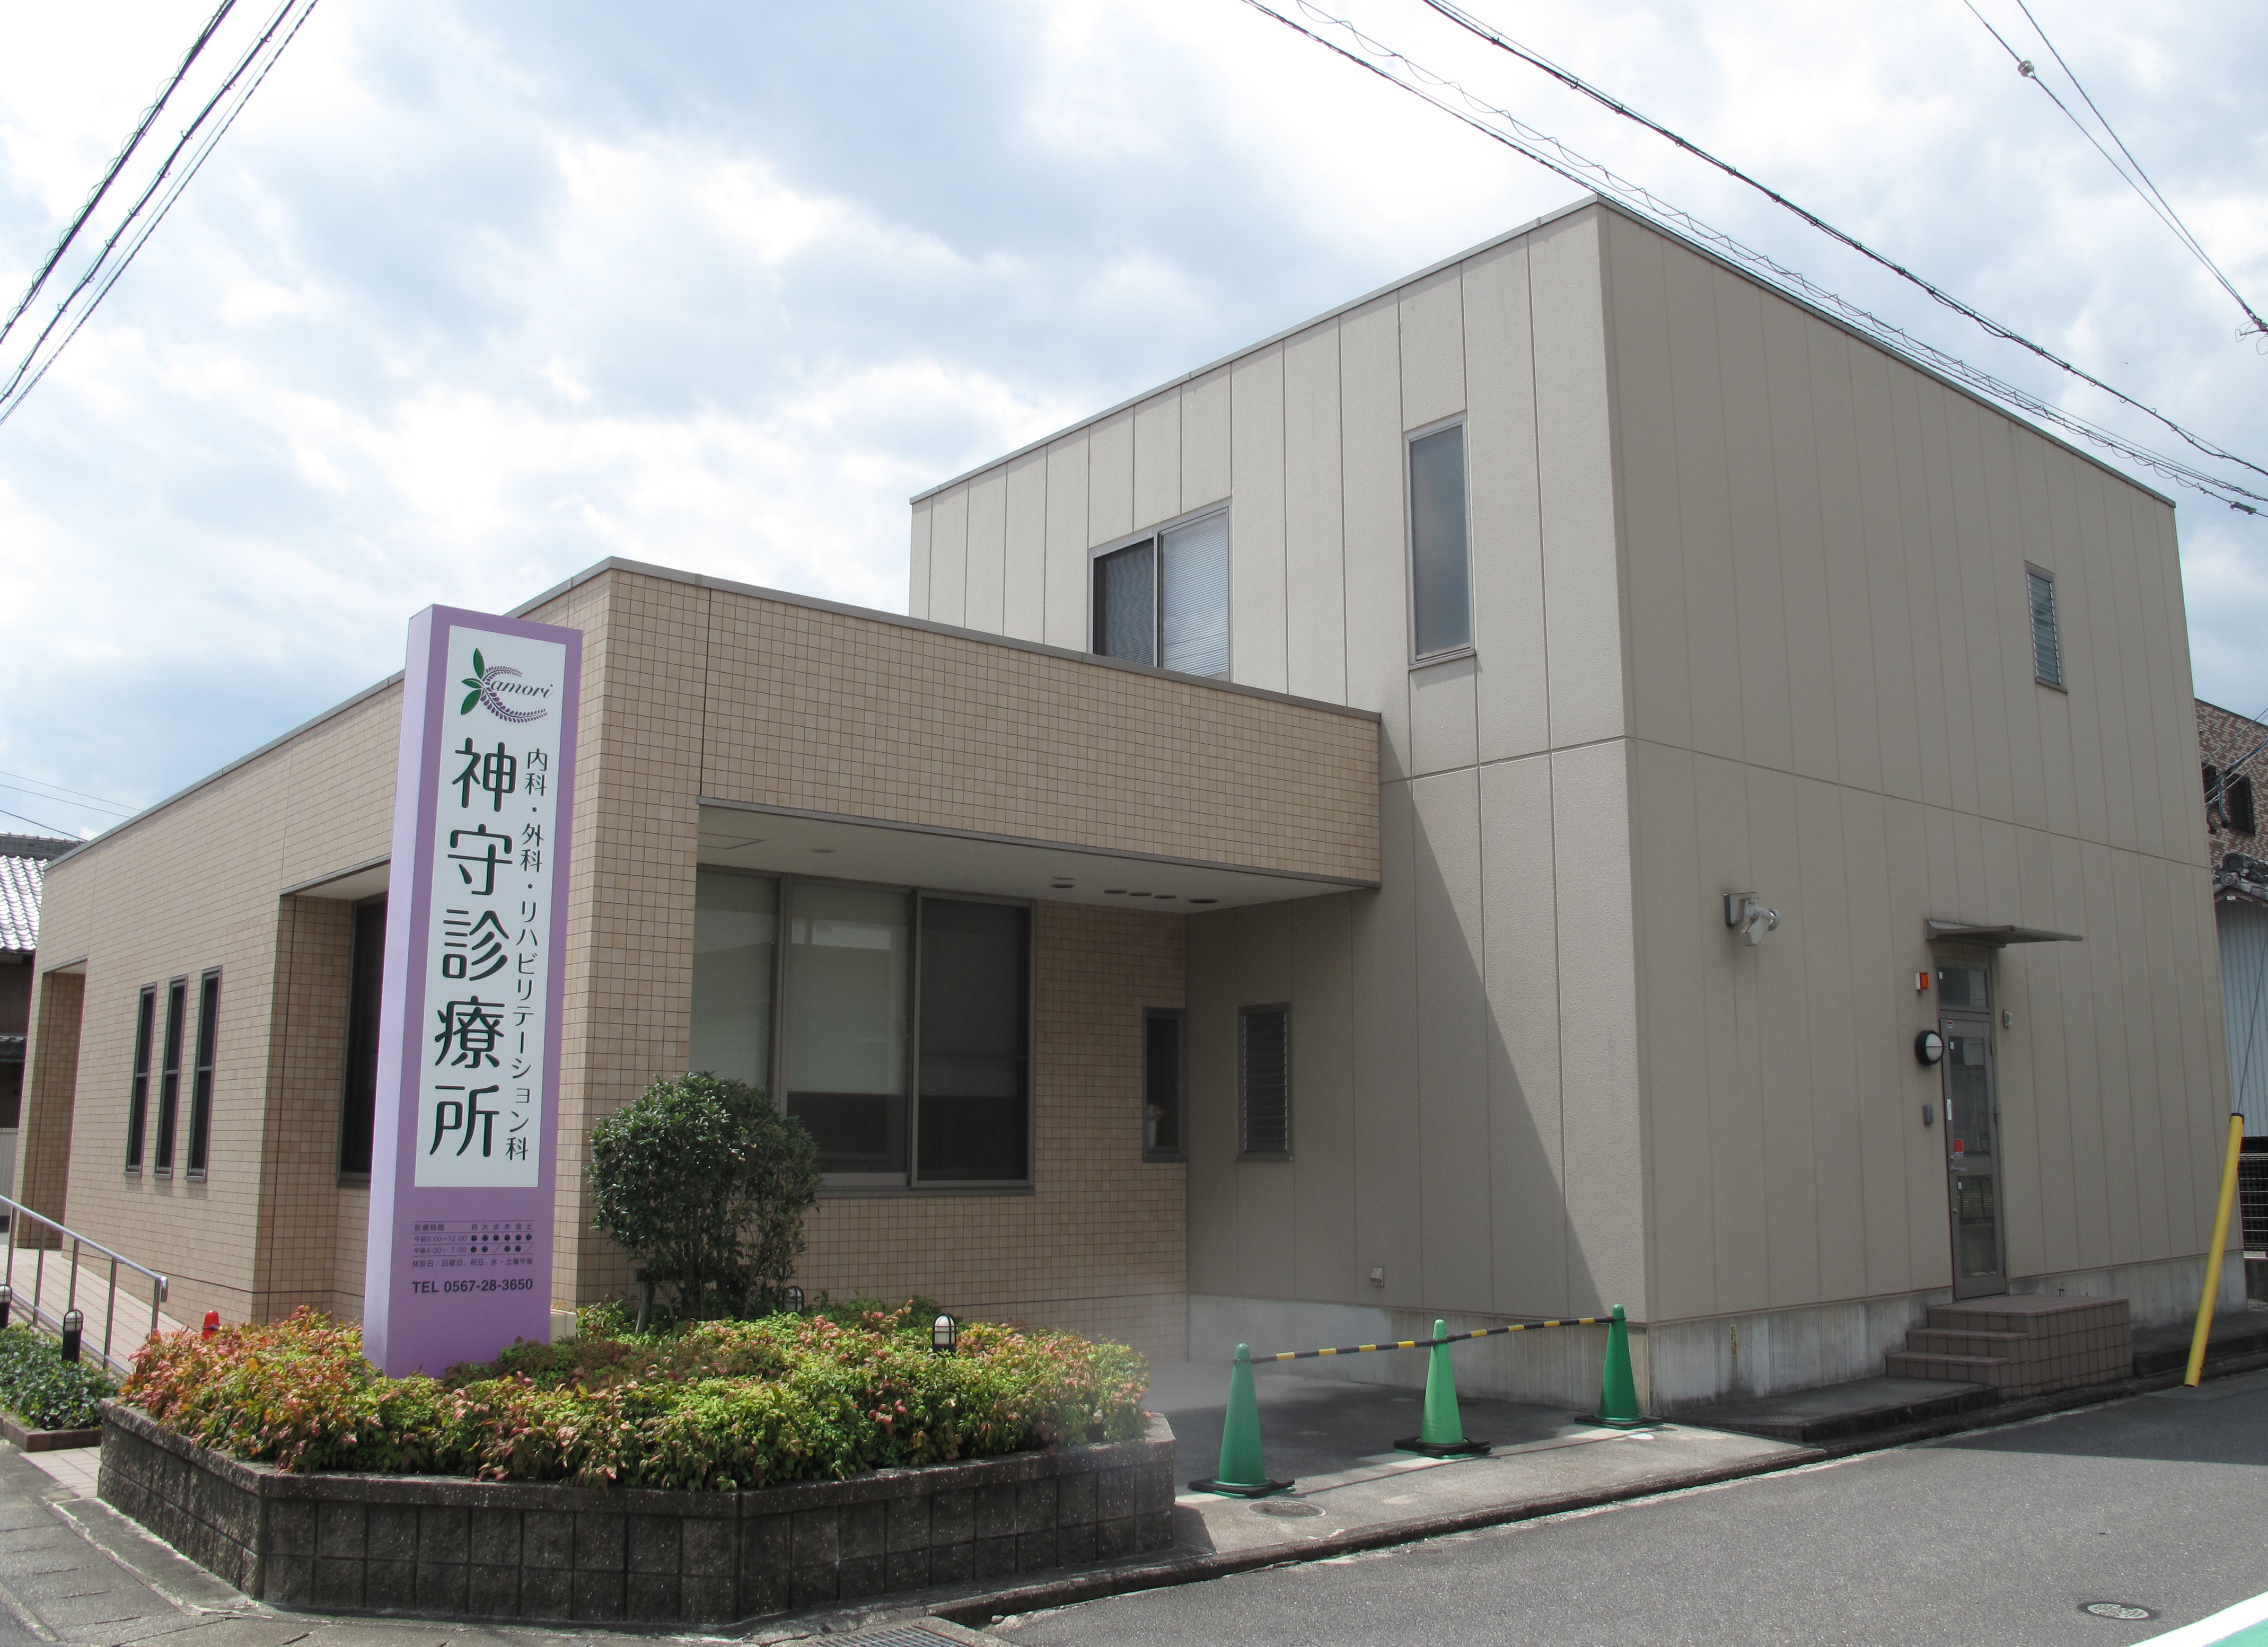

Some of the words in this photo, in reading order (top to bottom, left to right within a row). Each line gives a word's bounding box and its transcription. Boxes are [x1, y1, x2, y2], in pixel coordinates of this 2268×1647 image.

[429, 737, 517, 1158] 神守診療所
[412, 1281, 439, 1293] TEL
[444, 1278, 533, 1292] 0567-28-3650
